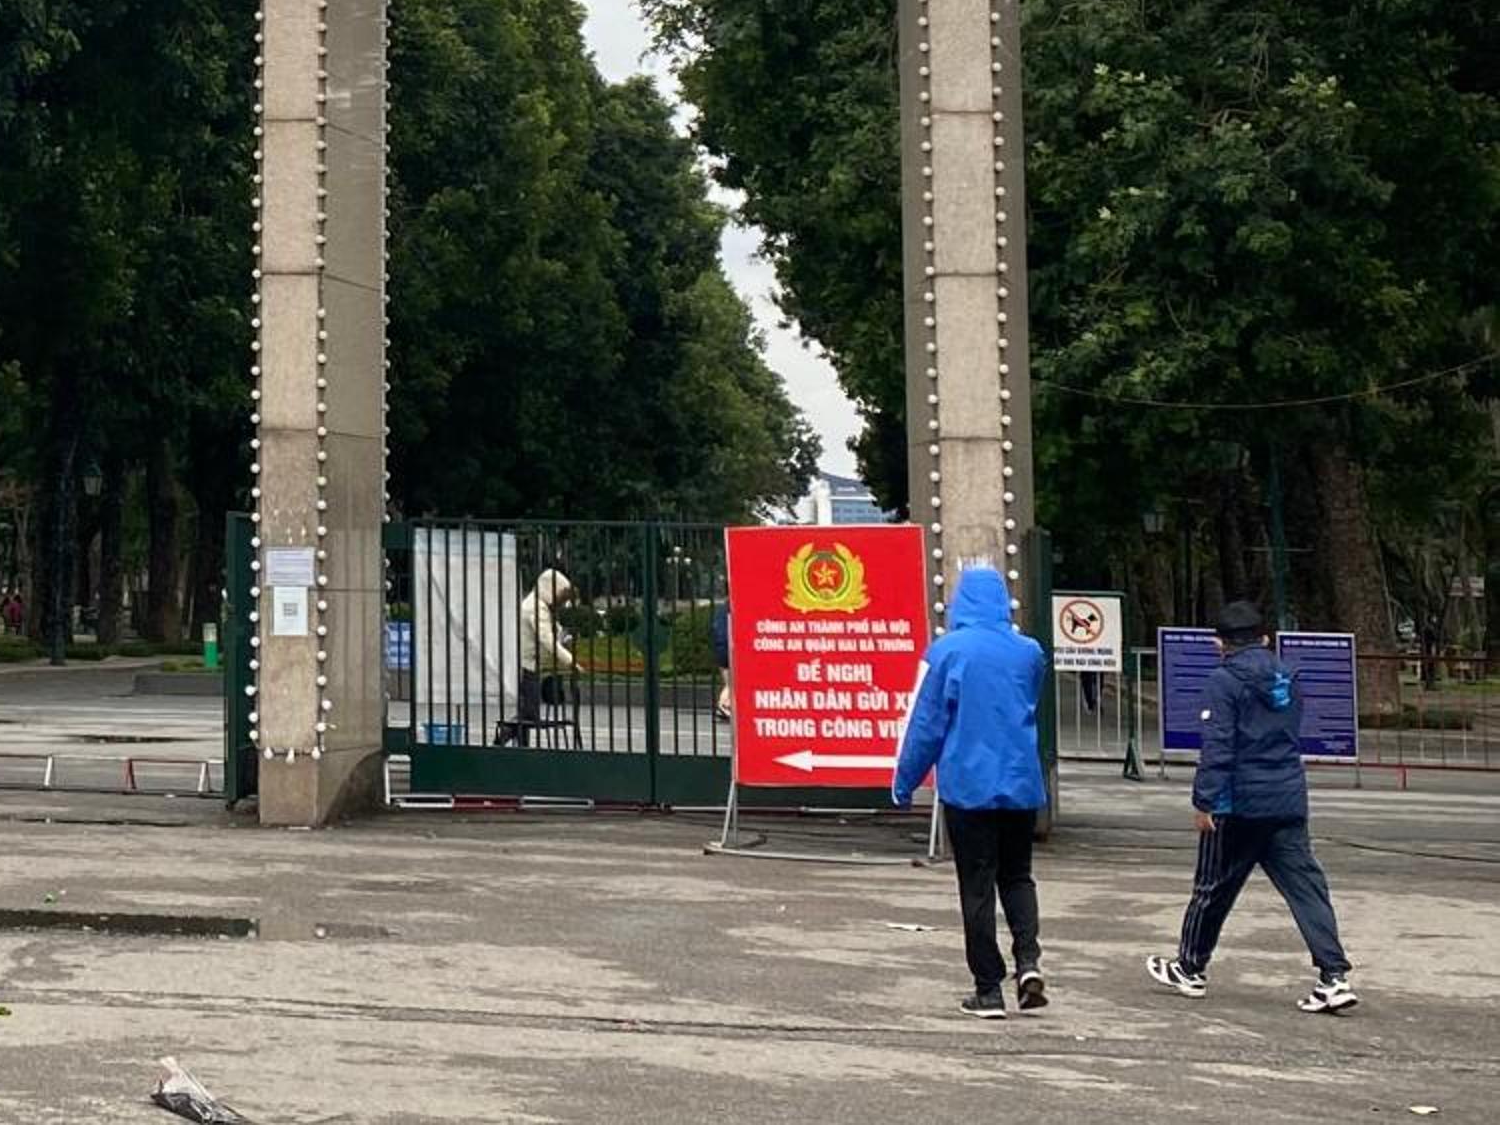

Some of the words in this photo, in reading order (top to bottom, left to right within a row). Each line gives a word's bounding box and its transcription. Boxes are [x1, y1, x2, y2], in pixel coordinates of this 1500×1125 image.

[753, 636, 785, 652] CÔNG
[826, 663, 873, 687] NGHỊ
[754, 687, 808, 711] NHÂN
[812, 688, 853, 711] DÂN
[753, 717, 817, 739] TRONG
[821, 715, 874, 739] CÔNG
